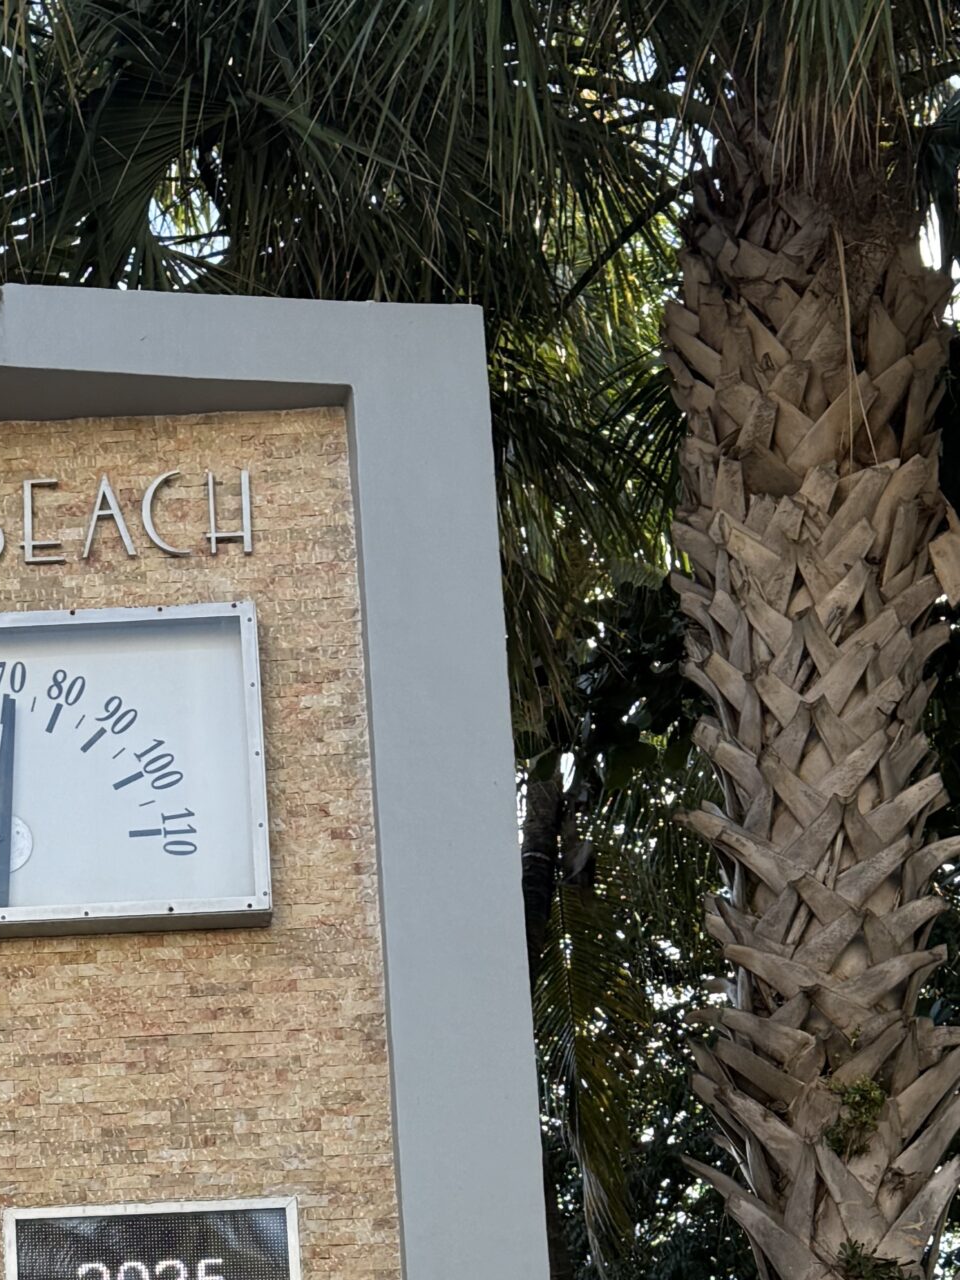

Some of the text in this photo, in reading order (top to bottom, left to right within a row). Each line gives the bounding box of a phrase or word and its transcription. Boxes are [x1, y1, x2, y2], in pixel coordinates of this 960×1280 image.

[46, 668, 86, 707] 80
[94, 695, 139, 735] 90
[133, 738, 184, 791] 100
[160, 807, 198, 856] 110
